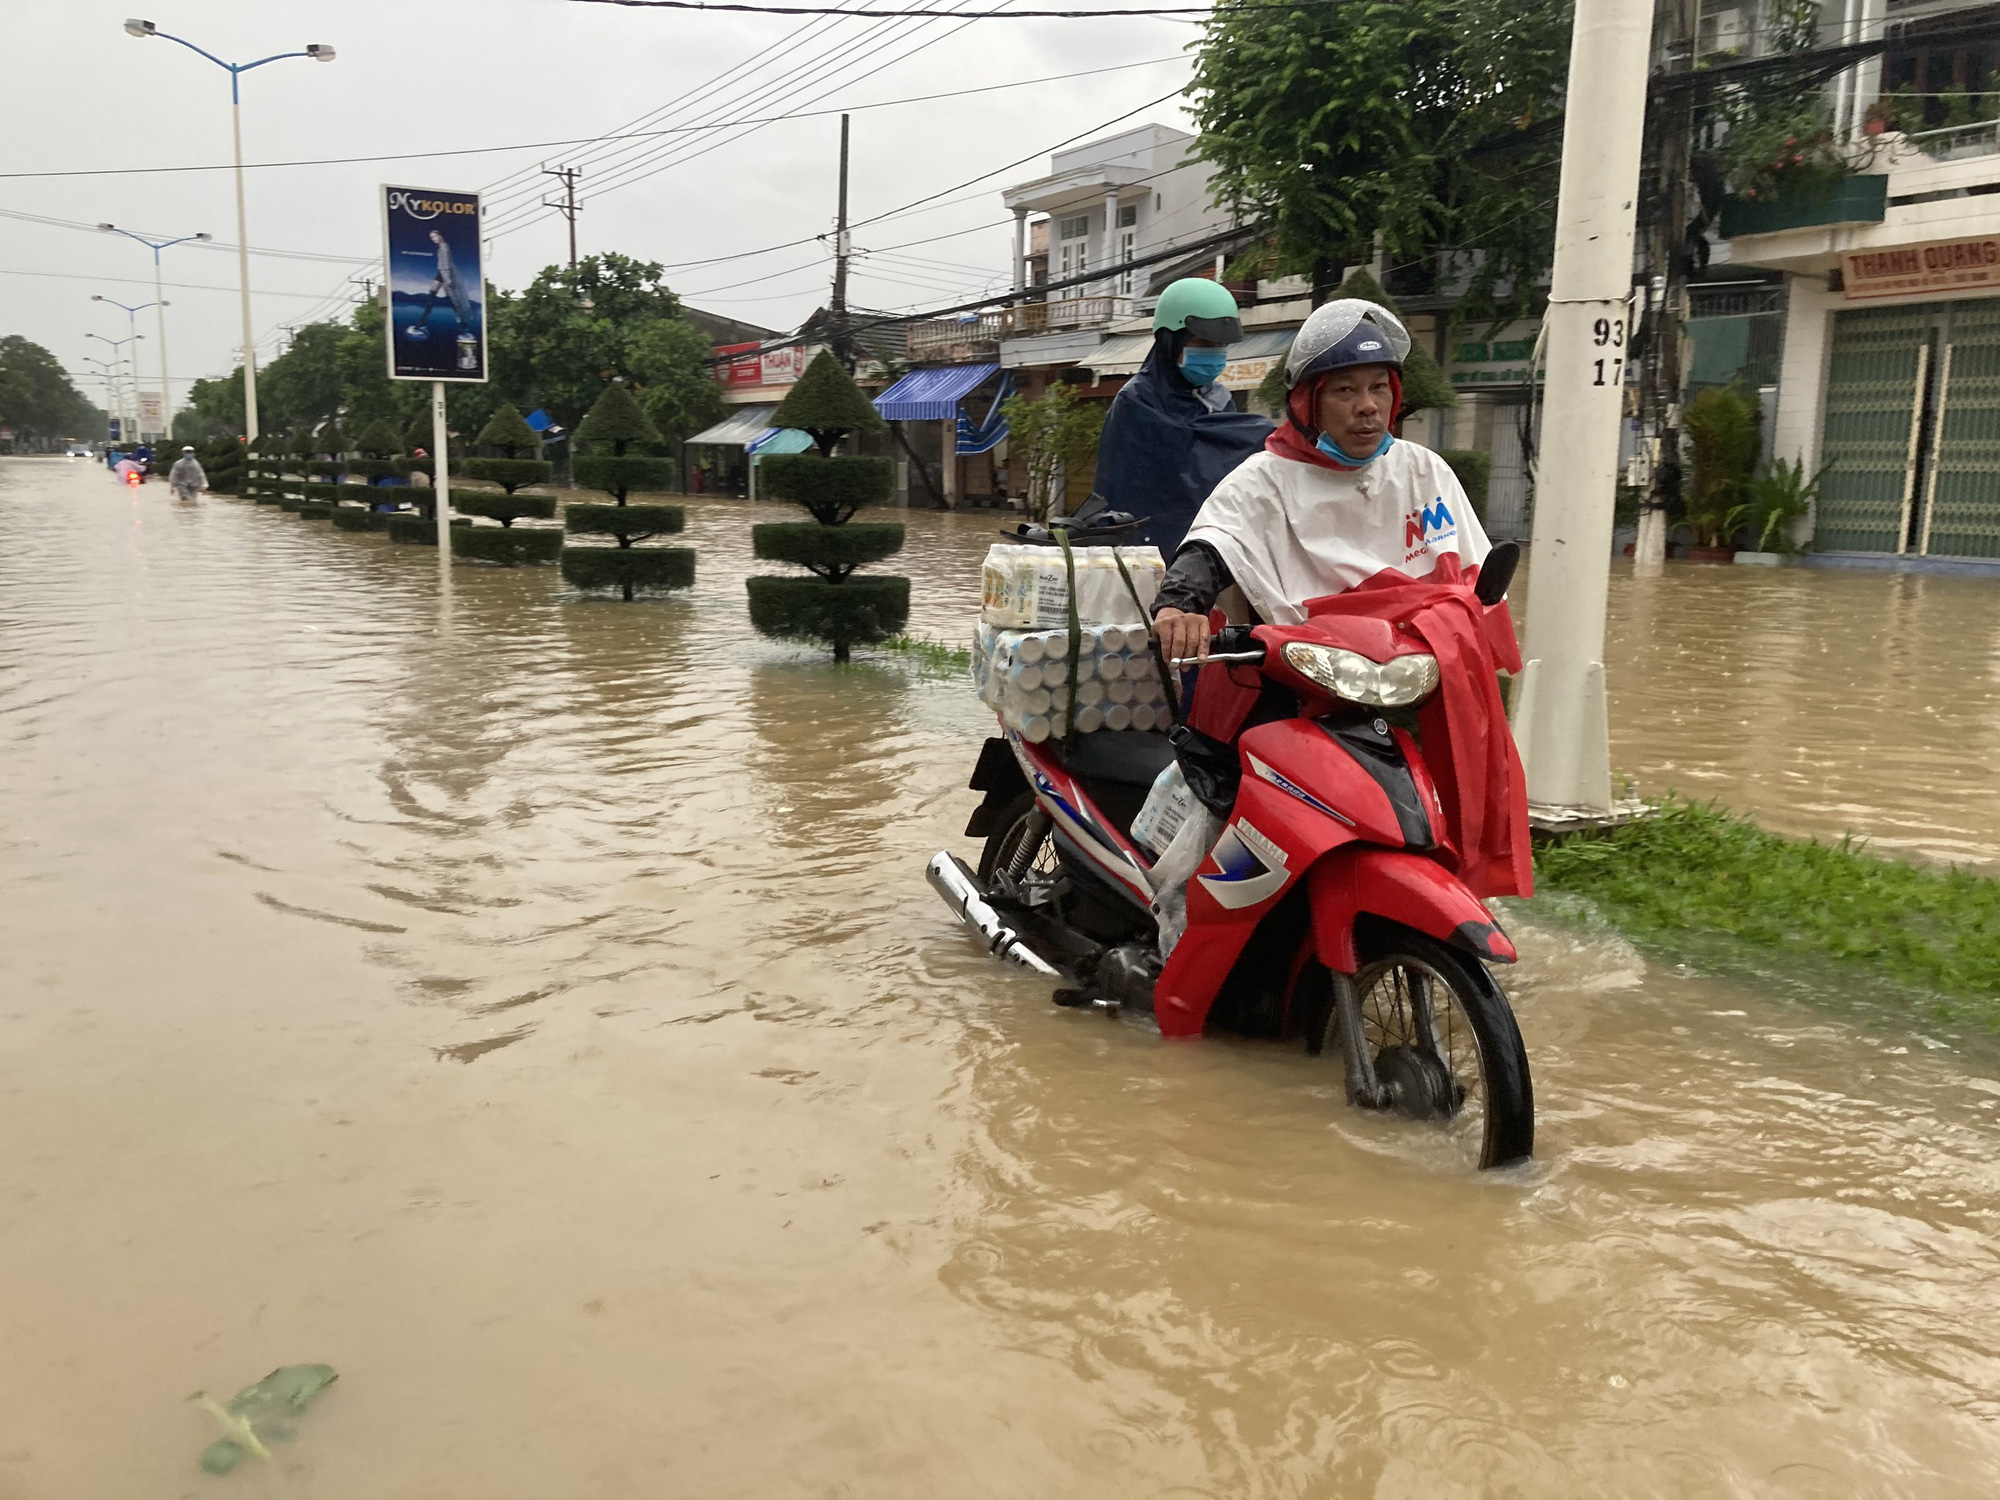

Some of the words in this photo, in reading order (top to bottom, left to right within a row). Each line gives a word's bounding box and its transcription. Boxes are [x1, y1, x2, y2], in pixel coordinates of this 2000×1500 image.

[1848, 249, 1920, 278] THANH
[1925, 241, 1998, 272] QUANG
[1593, 318, 1623, 347] 93
[1593, 358, 1622, 386] 17
[1239, 818, 1286, 863] YAMAHA
